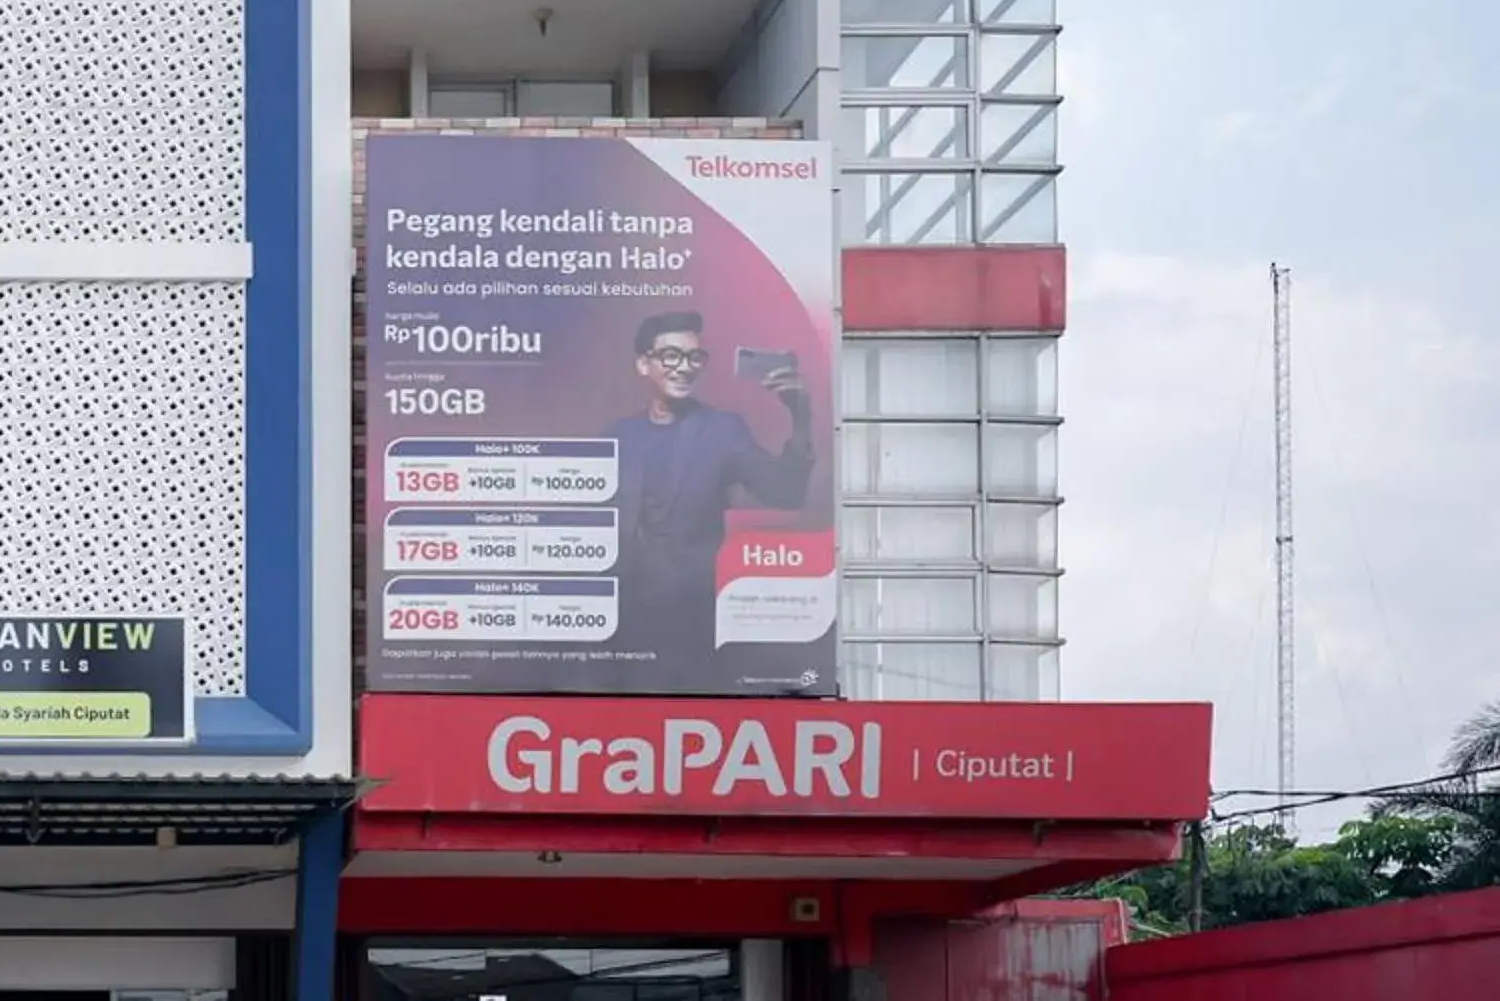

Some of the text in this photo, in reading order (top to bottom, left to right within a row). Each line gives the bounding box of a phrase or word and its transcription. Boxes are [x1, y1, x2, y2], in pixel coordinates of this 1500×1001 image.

[685, 155, 817, 179] Telkomsel
[387, 208, 693, 239] Pegang kendali tanpa
[386, 244, 499, 269] kendala
[505, 244, 612, 275] dengan
[387, 281, 693, 299] Selalu ada pilihan sesuai kebutuhan
[385, 388, 485, 414] 150GB
[396, 470, 459, 493] 13GB
[469, 476, 516, 490] +10GB
[397, 540, 458, 561] 17GB
[469, 544, 517, 558] +10GB
[742, 544, 804, 567] Halo
[389, 608, 459, 630] 20GB
[469, 613, 516, 627] +10GB
[13, 705, 71, 722] Syariah
[73, 706, 130, 722] Ciputat
[487, 716, 882, 798] GraPARI
[935, 749, 1054, 783] Ciputat
